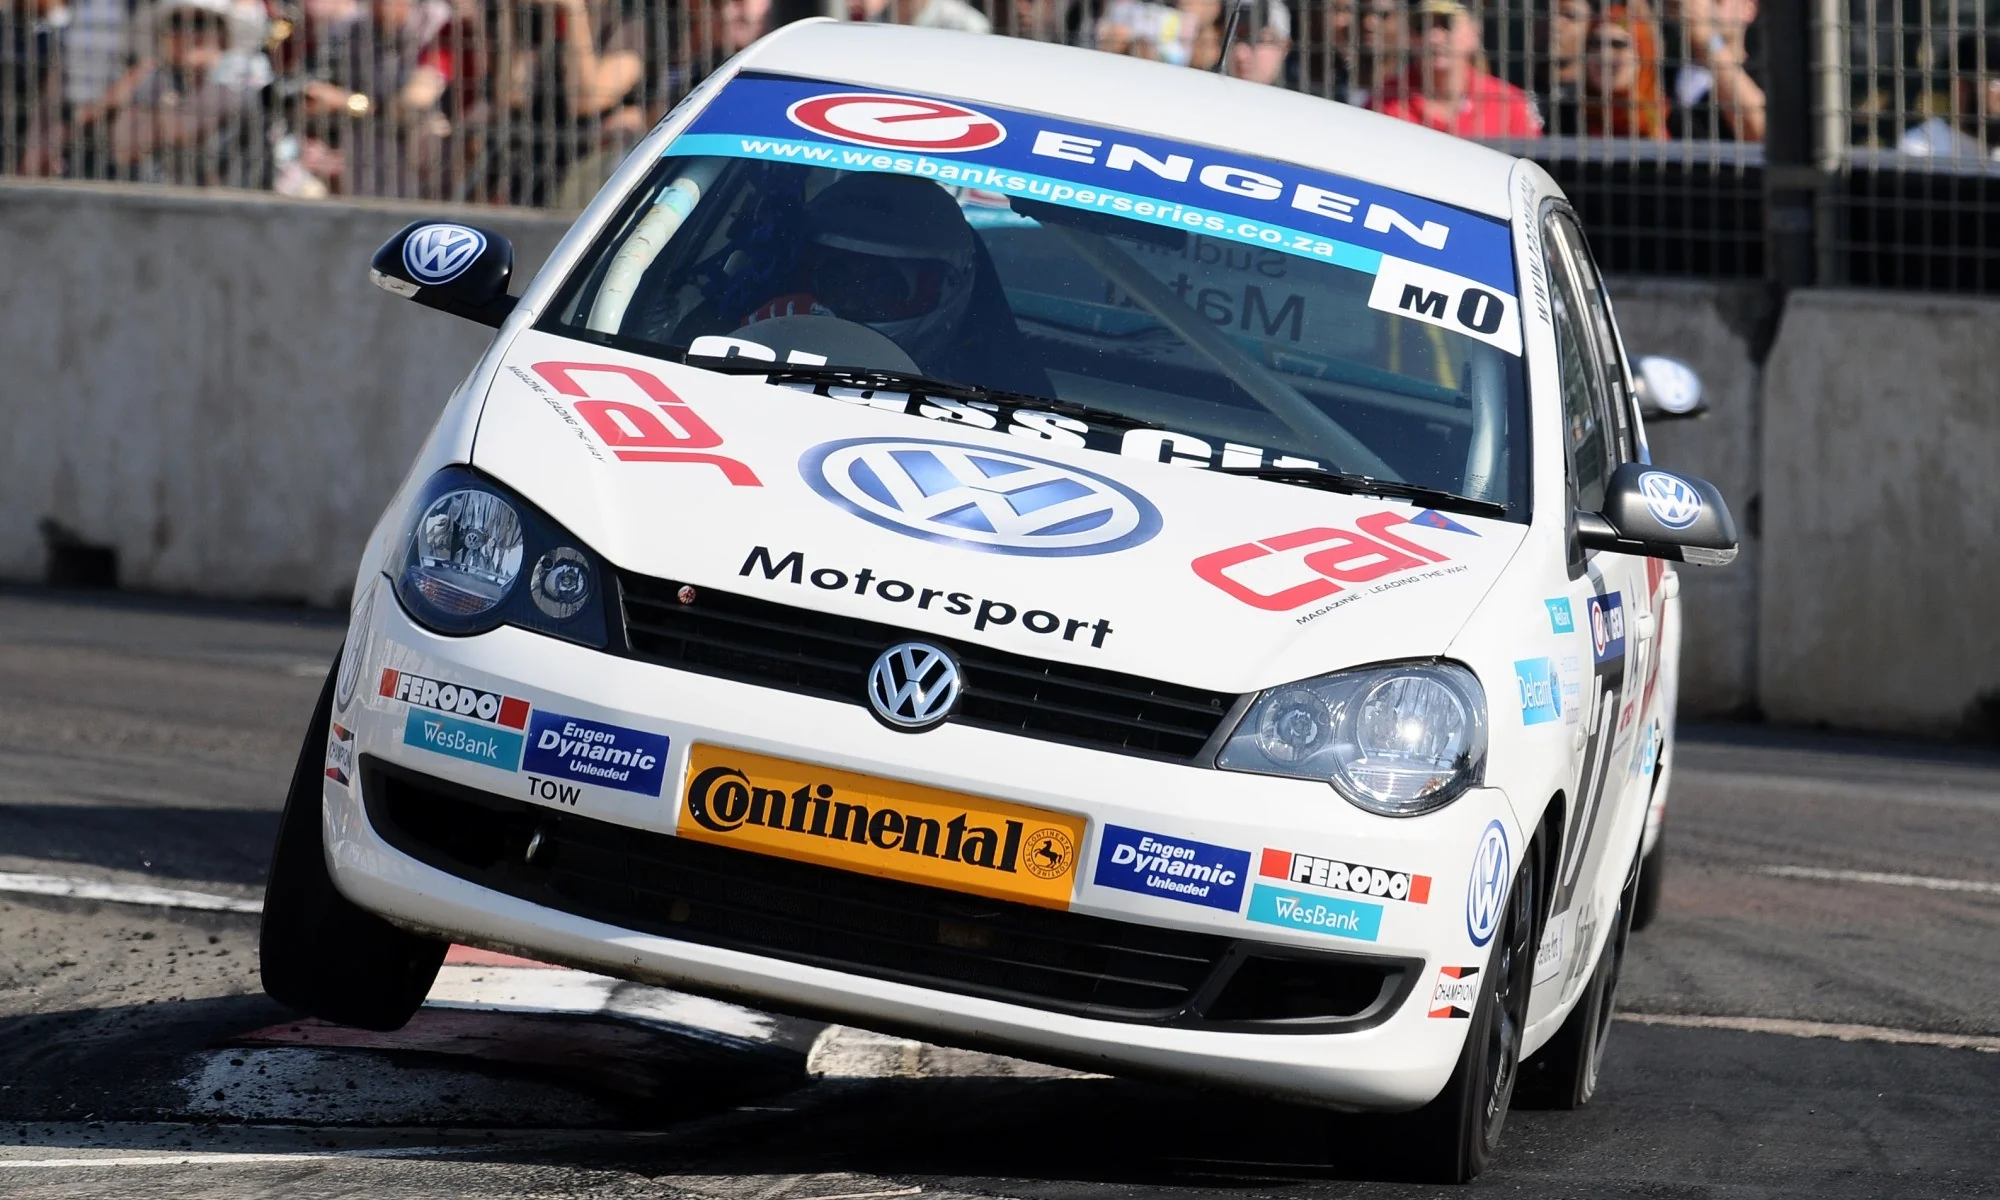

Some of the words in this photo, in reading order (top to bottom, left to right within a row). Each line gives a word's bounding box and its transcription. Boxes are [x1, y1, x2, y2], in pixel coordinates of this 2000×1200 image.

[741, 138, 1334, 258] www.wesbanksuperseries.co.za
[1032, 130, 1450, 251] ENGEN
[738, 545, 1113, 649] Motorsport
[1296, 593, 1362, 625] MAGAZINE
[1368, 575, 1421, 595] LEADING
[1419, 569, 1445, 581] THE
[1445, 564, 1469, 575] WAY
[395, 673, 499, 722] FERODO
[422, 719, 498, 760] WesBank
[536, 728, 657, 771] Dynamic
[562, 721, 616, 746] Engen
[527, 776, 581, 806] TOW
[569, 759, 630, 783] Unleaded
[687, 765, 1024, 874] Continental
[1110, 843, 1237, 887] Dynamic
[1138, 836, 1196, 860] Engen
[1146, 874, 1210, 899] Unleaded
[1291, 854, 1408, 900] FERODO
[1274, 896, 1360, 932] WesBank
